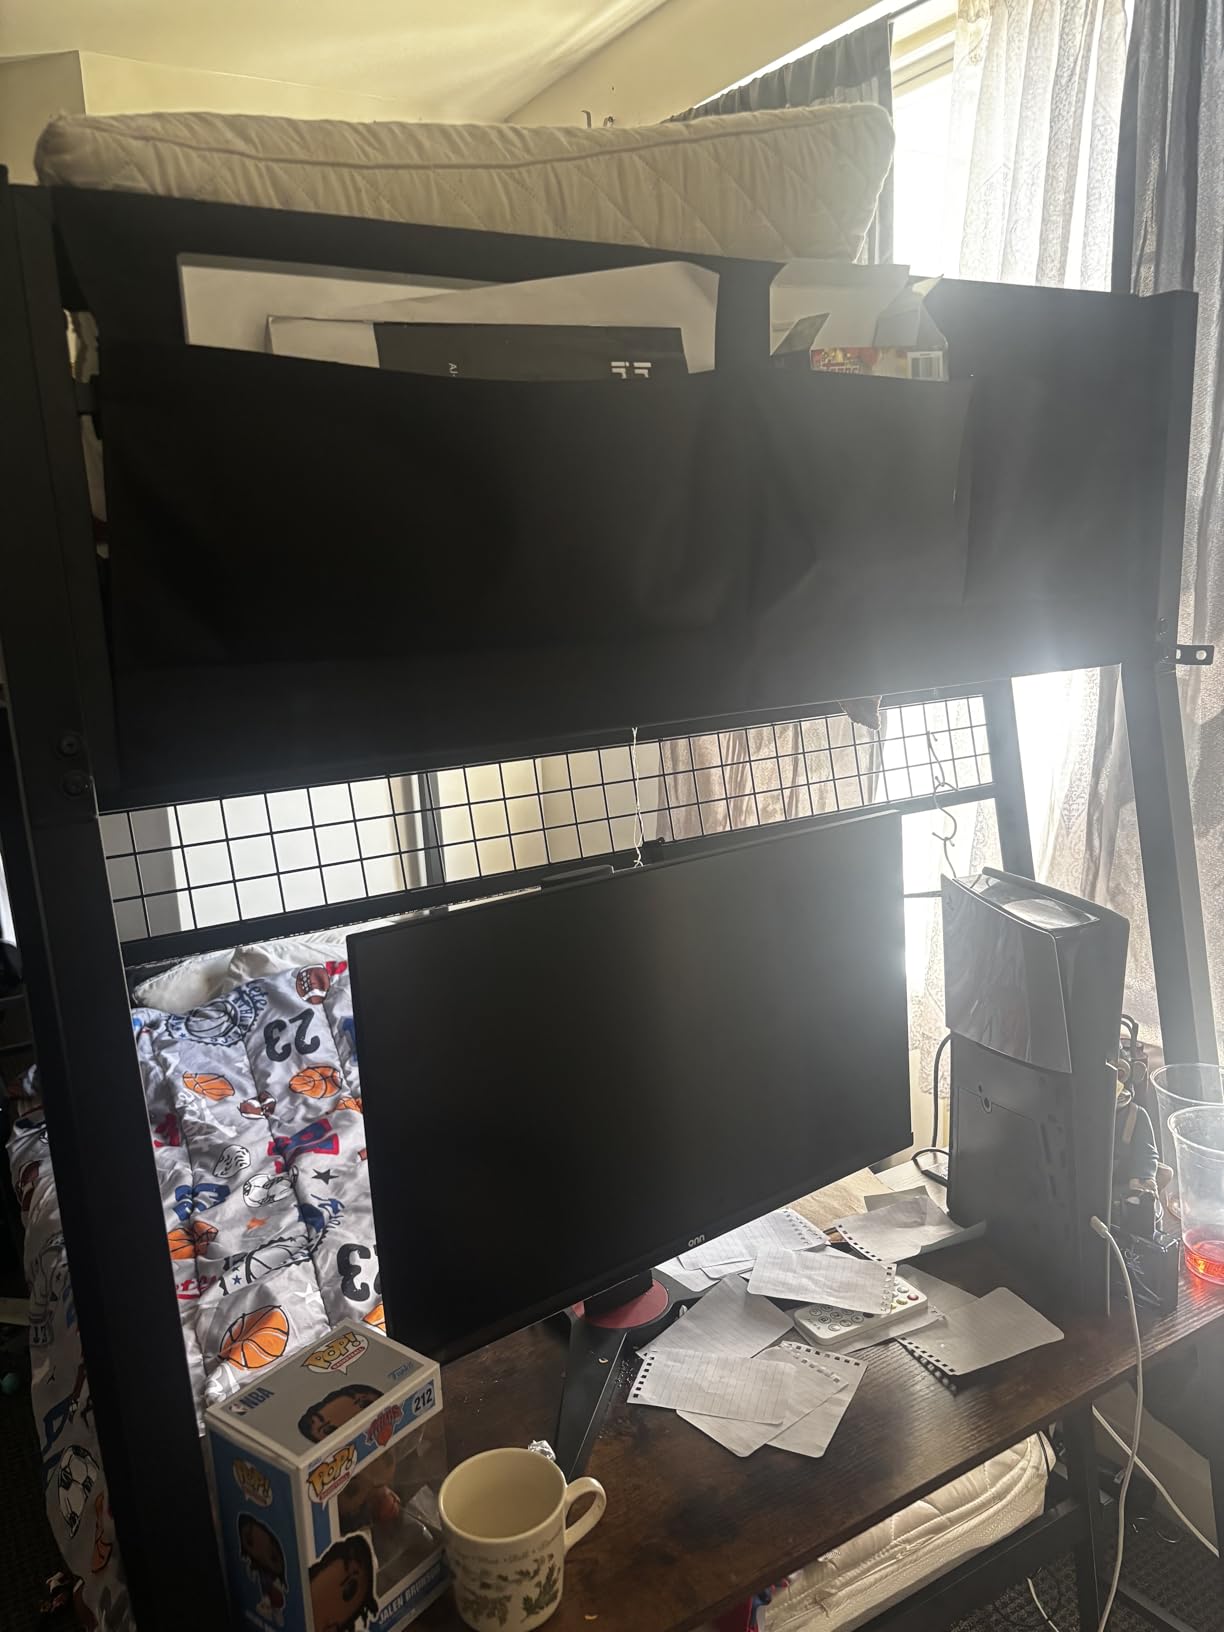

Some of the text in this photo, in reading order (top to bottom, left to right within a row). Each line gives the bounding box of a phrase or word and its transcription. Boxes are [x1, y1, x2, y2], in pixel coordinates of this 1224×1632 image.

[687, 1234, 705, 1248] onn
[301, 1332, 361, 1369] POP!
[240, 1387, 274, 1409] NBA
[414, 1388, 433, 1413] 212
[306, 1443, 355, 1498] POP!
[379, 1594, 405, 1624] JALEN
